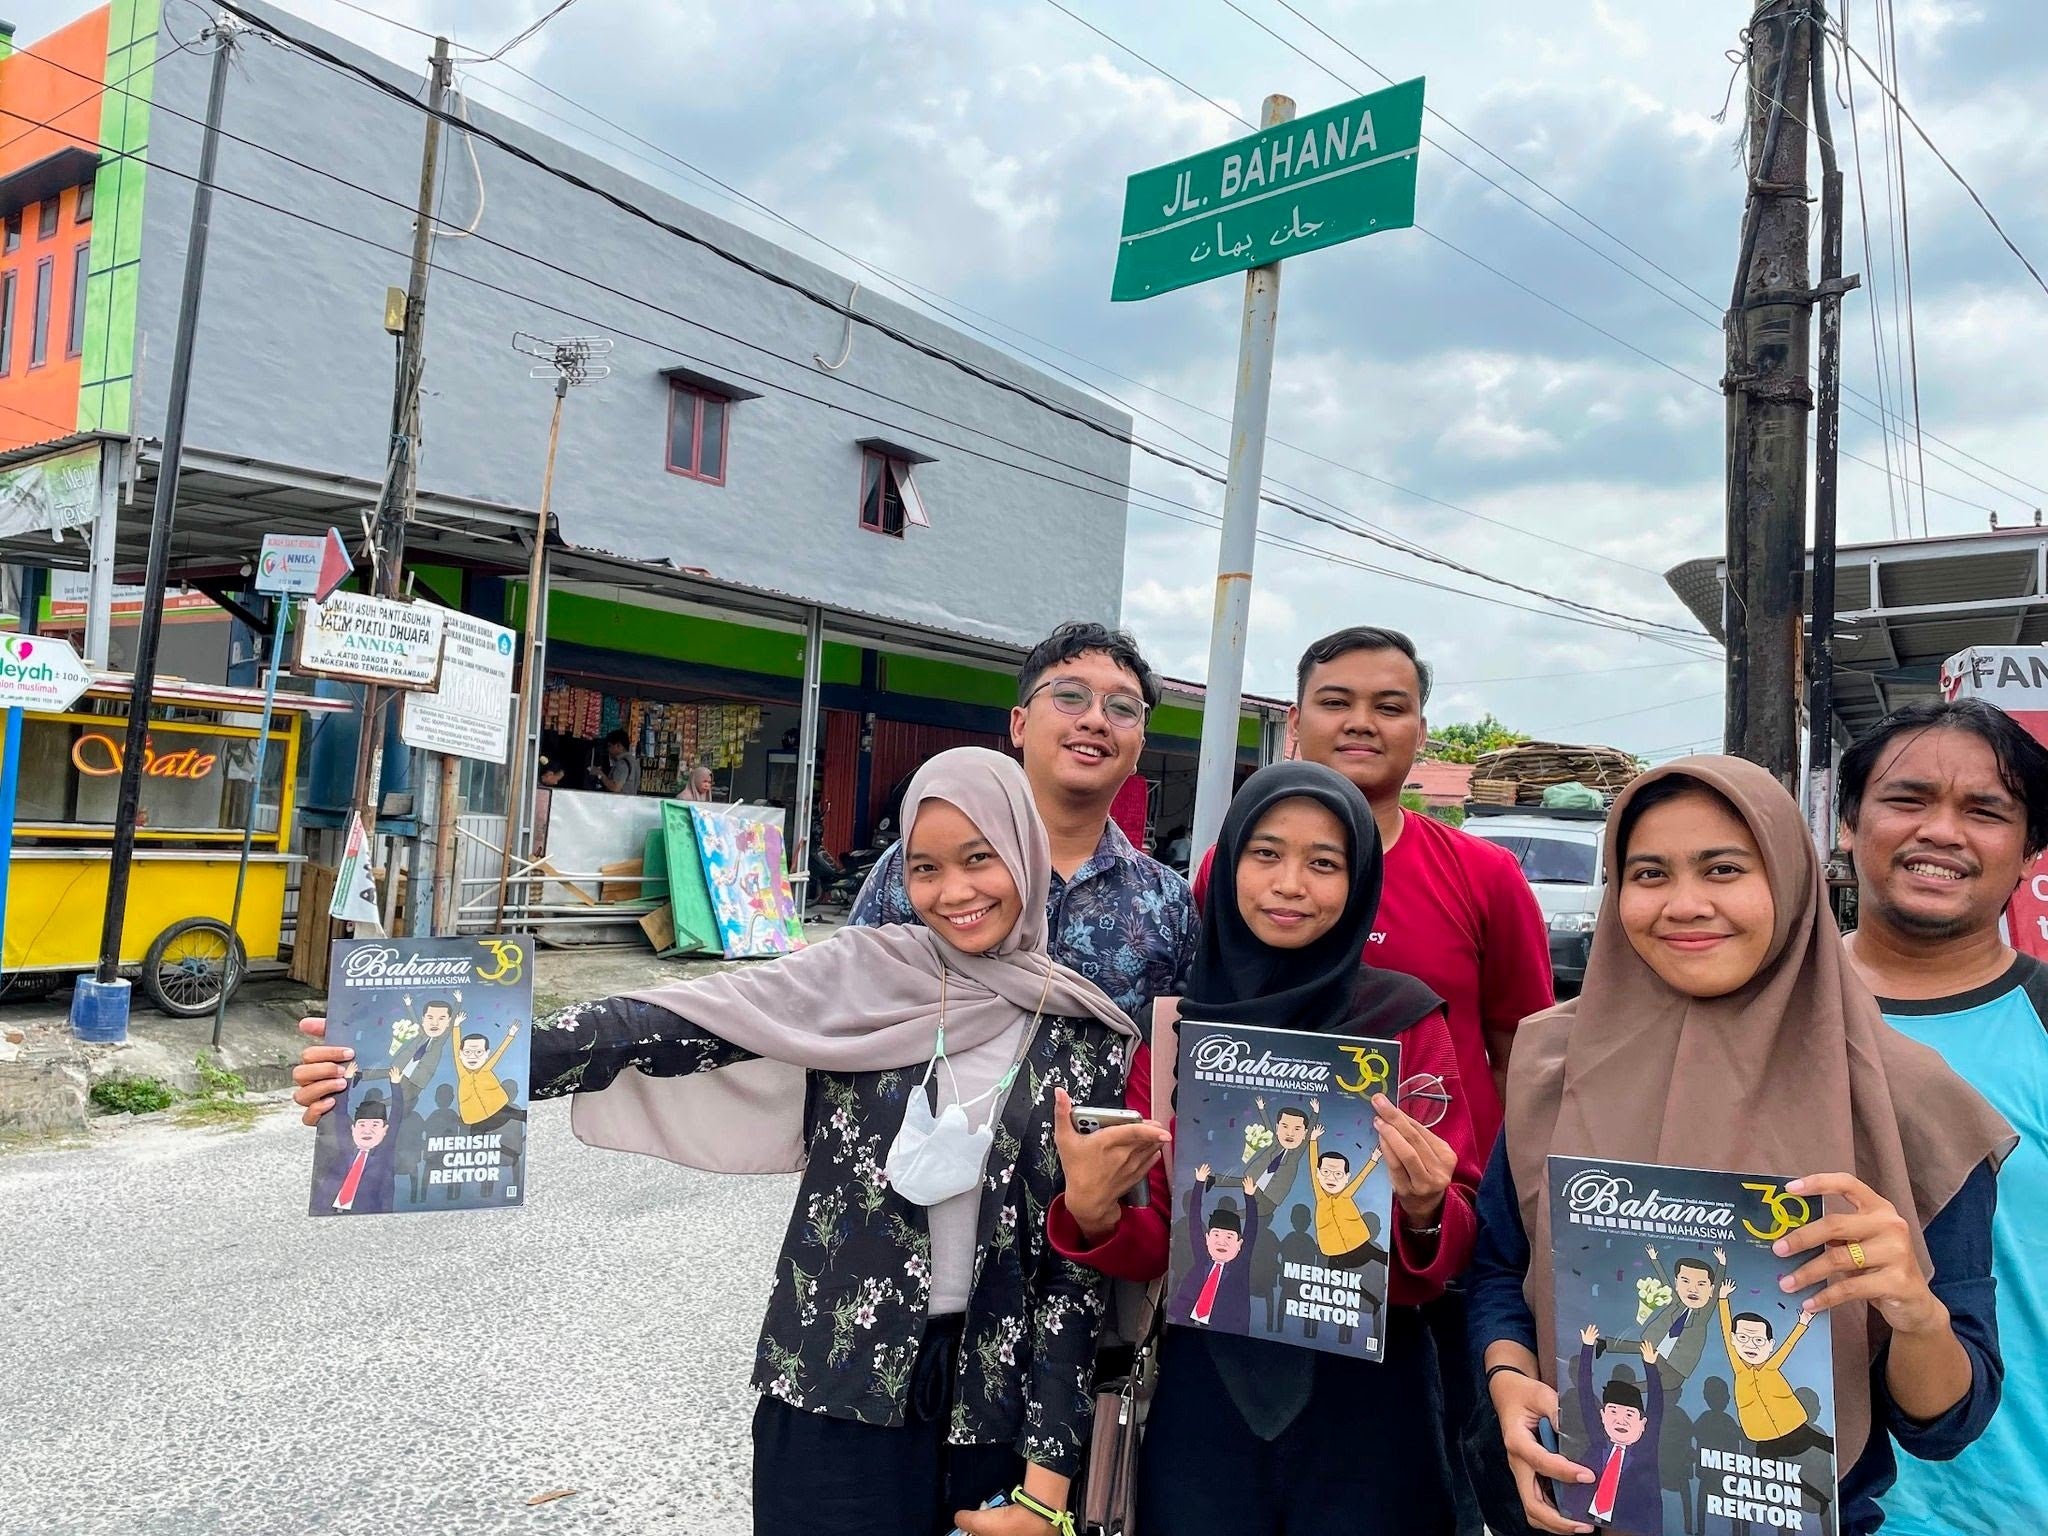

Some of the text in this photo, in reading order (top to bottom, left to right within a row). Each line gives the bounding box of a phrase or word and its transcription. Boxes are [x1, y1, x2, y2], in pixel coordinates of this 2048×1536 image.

[1162, 109, 1377, 217] JL. BAHANA
[319, 612, 353, 632] YATIM
[355, 620, 386, 637] PIATU
[355, 604, 376, 618] ASUH
[380, 607, 400, 621] PANTI
[401, 610, 432, 627] ASUHAN
[310, 656, 430, 680] TANGKERANG TENGAH PEKANBARU
[361, 654, 389, 666] DAKOTA
[17, 683, 58, 694] muslimah
[63, 672, 79, 681] 100
[345, 946, 472, 978] Bahana
[421, 976, 471, 985] MAHASISWA
[1194, 1037, 1330, 1081] Bahana
[1275, 1079, 1330, 1093] MAHASISWA
[427, 1134, 502, 1152] MERISIK
[442, 1150, 501, 1168] CALON
[429, 1167, 500, 1185] REKTOR
[1568, 1173, 1736, 1228] Bahana
[1666, 1223, 1737, 1241] MAHASISWA
[1283, 1261, 1362, 1291] MERISIK
[1299, 1283, 1361, 1309] CALON
[1285, 1298, 1360, 1328] REKTOR
[1700, 1447, 1803, 1485] MERISIK
[1721, 1474, 1803, 1508] CALON
[1706, 1493, 1803, 1532] REKTOR
